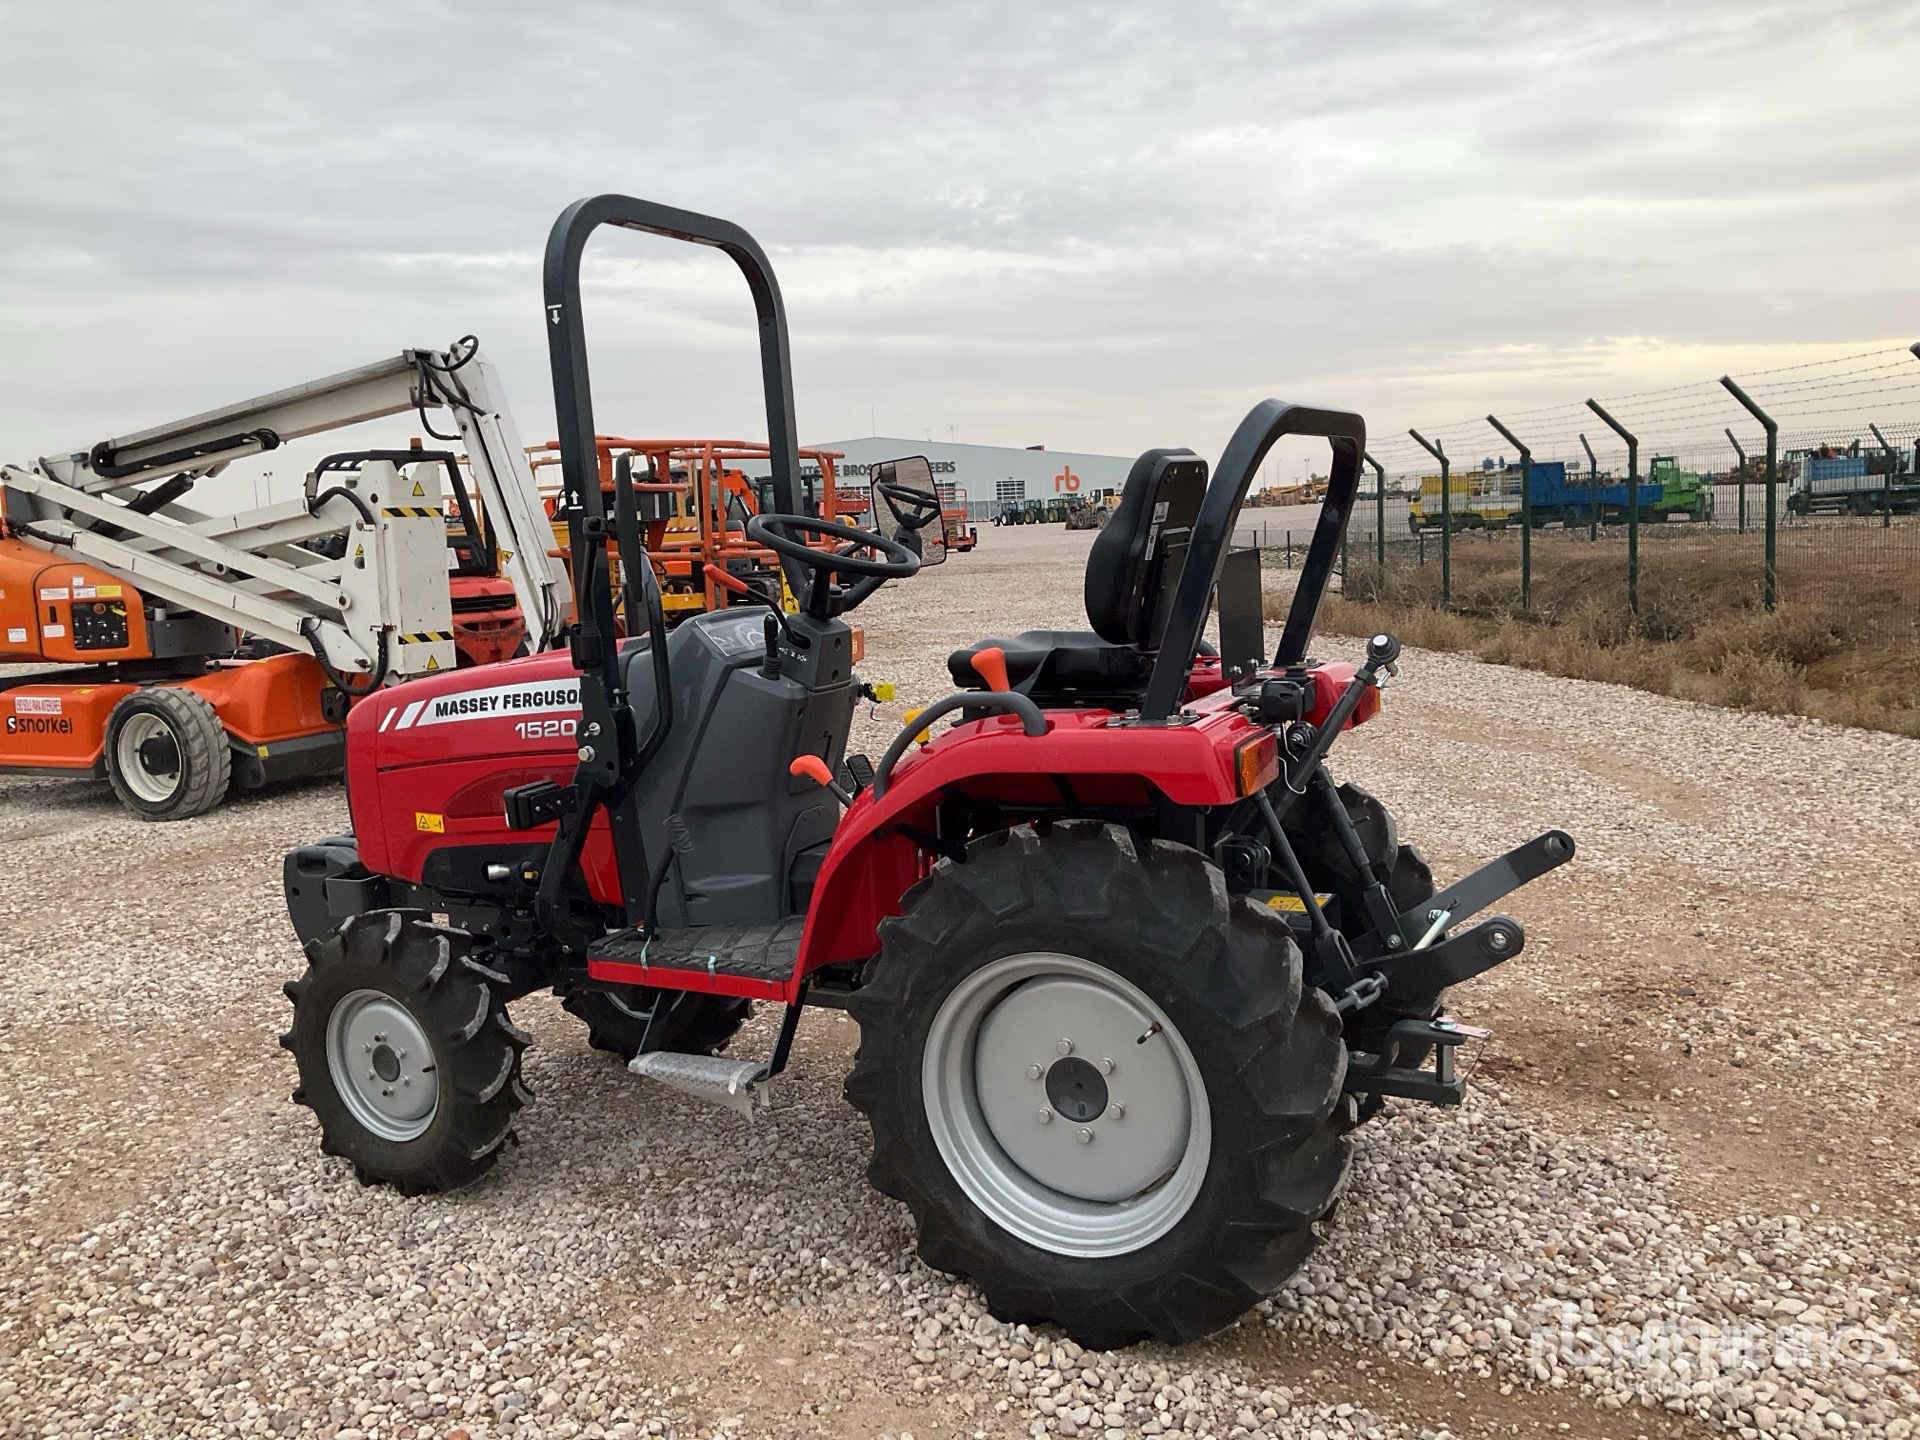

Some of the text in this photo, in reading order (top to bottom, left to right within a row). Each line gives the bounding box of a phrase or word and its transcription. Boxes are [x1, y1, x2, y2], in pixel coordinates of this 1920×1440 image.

[1055, 465, 1080, 492] rb
[435, 689, 582, 717] MASSEY FERGUSO
[19, 717, 73, 734] snorkel
[515, 719, 577, 739] 1520
